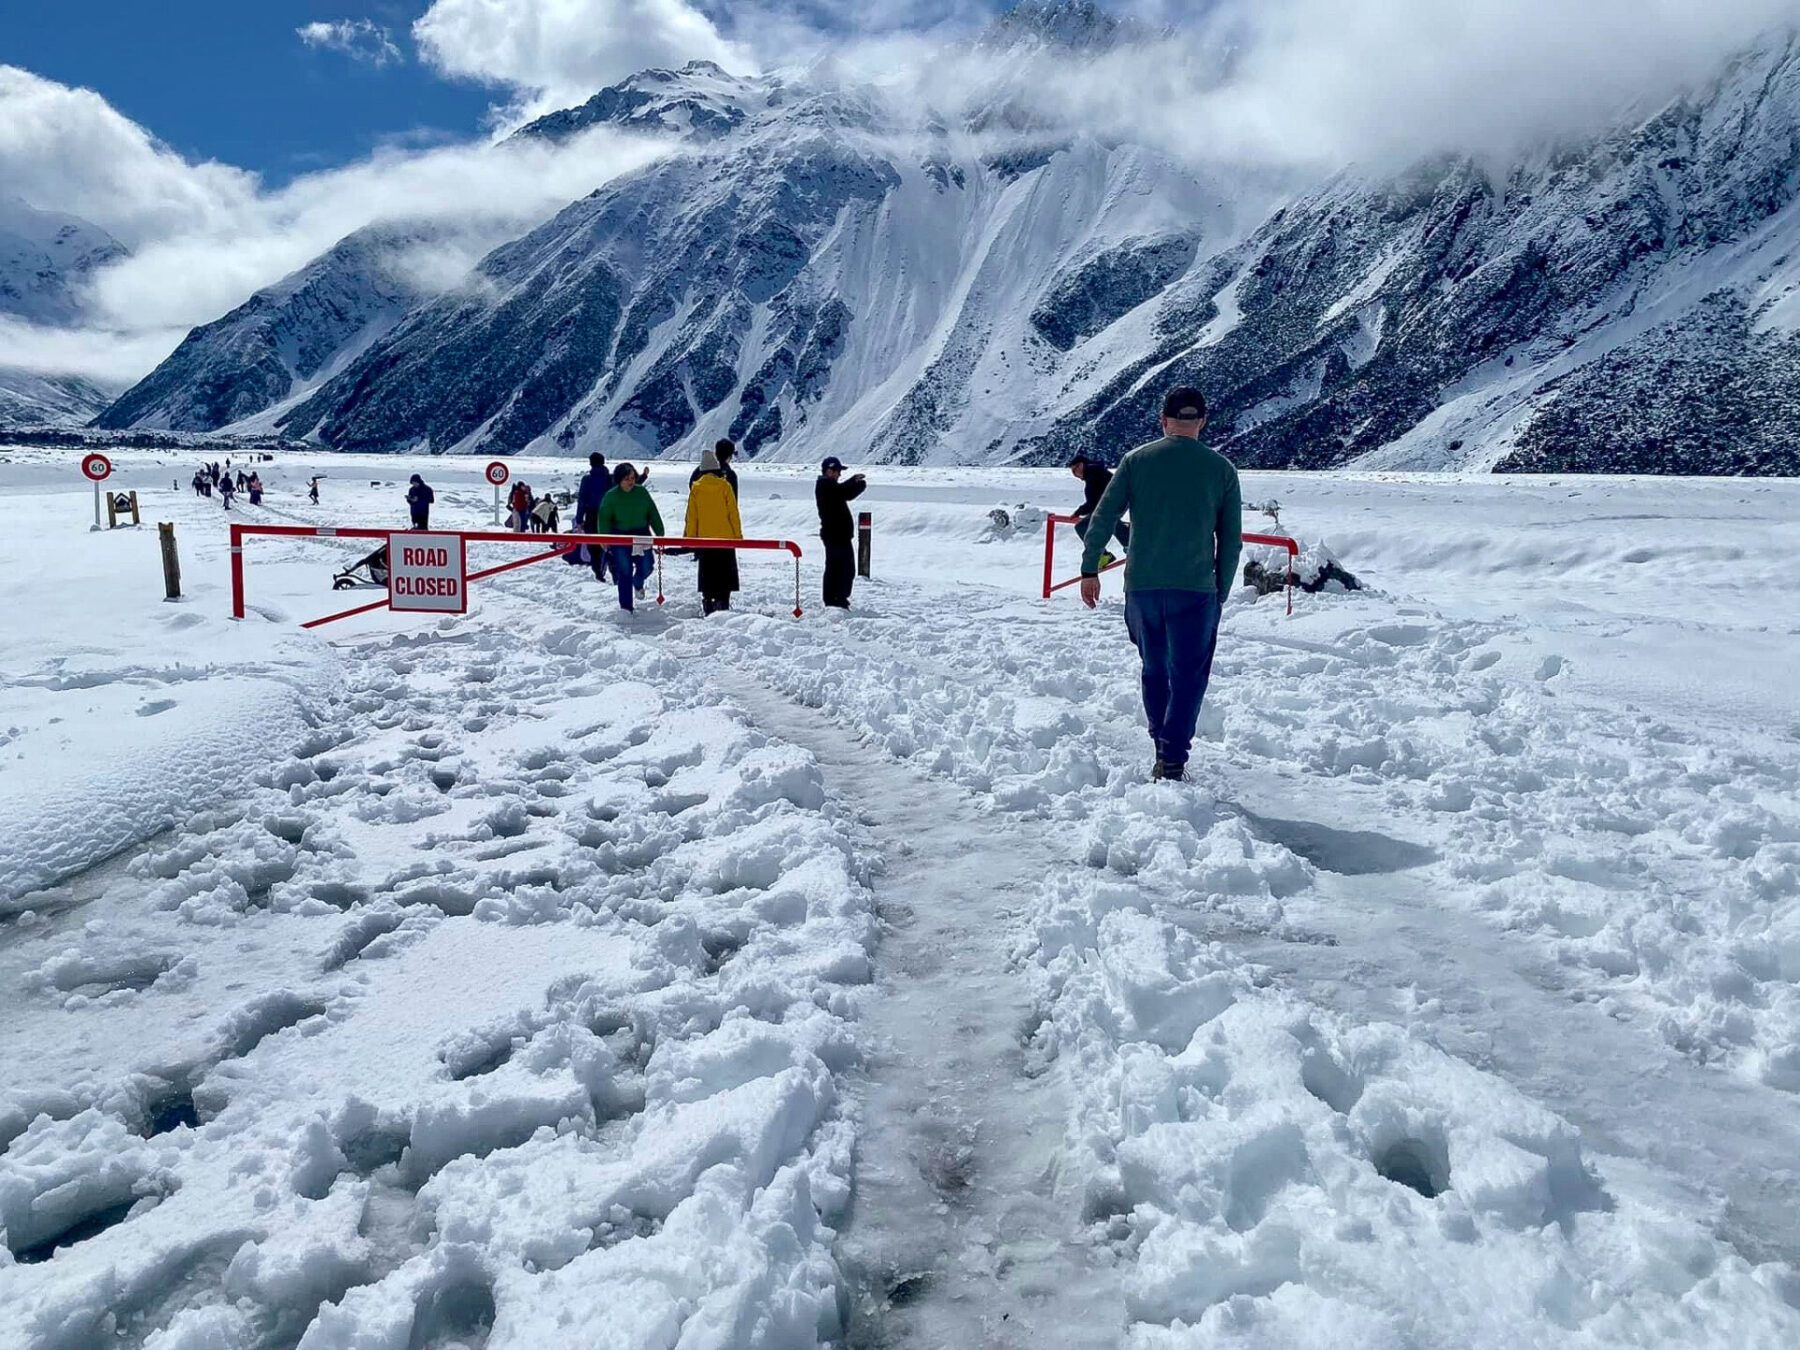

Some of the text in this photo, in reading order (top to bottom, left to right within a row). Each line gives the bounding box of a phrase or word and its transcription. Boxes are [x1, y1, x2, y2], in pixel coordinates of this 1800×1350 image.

[91, 463, 105, 472] 60
[492, 469, 505, 478] 60
[403, 547, 448, 567] ROAD
[395, 576, 458, 597] CLOSED
